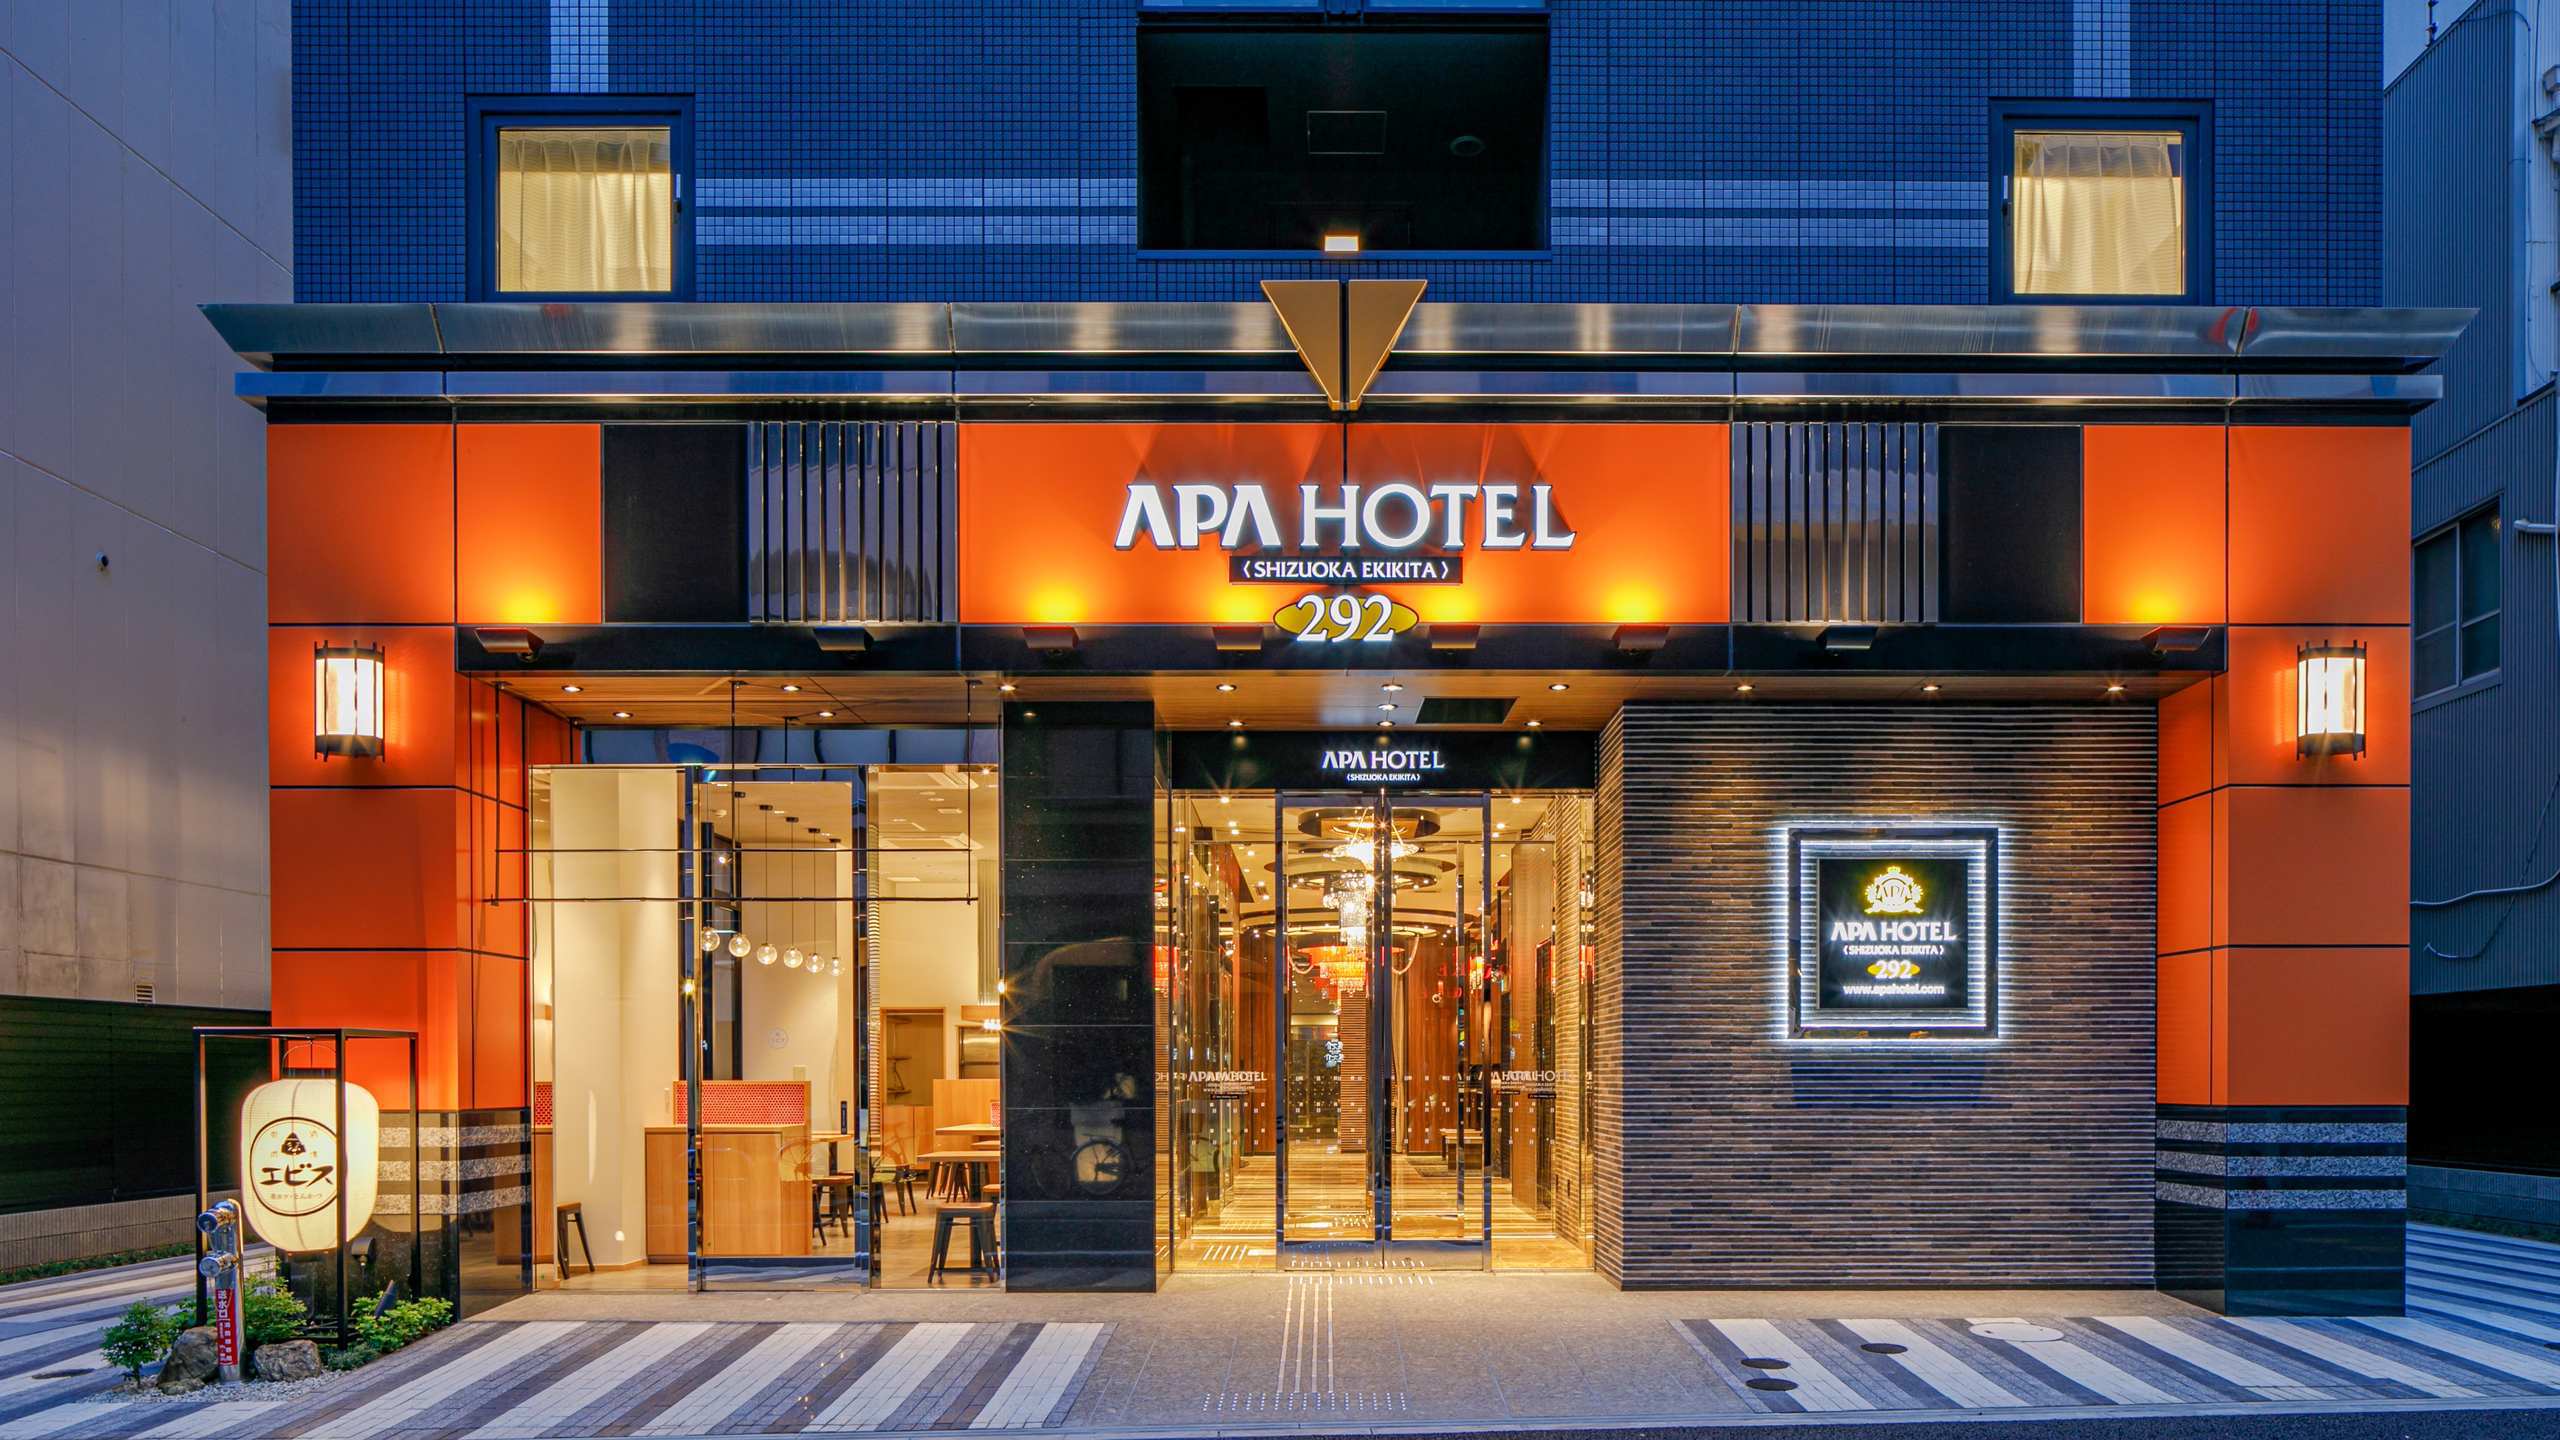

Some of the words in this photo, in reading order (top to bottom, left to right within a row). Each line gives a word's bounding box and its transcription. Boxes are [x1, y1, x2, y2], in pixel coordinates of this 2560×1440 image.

[1114, 483, 1282, 551] APA
[1298, 483, 1578, 551] HOTEL
[1295, 593, 1395, 643] 292
[1321, 750, 1368, 769] APA
[1370, 750, 1447, 769] HOTEL
[1830, 921, 1877, 941] APA
[1880, 921, 1958, 941] HOTEL
[1875, 960, 1912, 979] 292
[1843, 984, 1945, 996] www.apahotel.com
[259, 1162, 334, 1187] エビス
